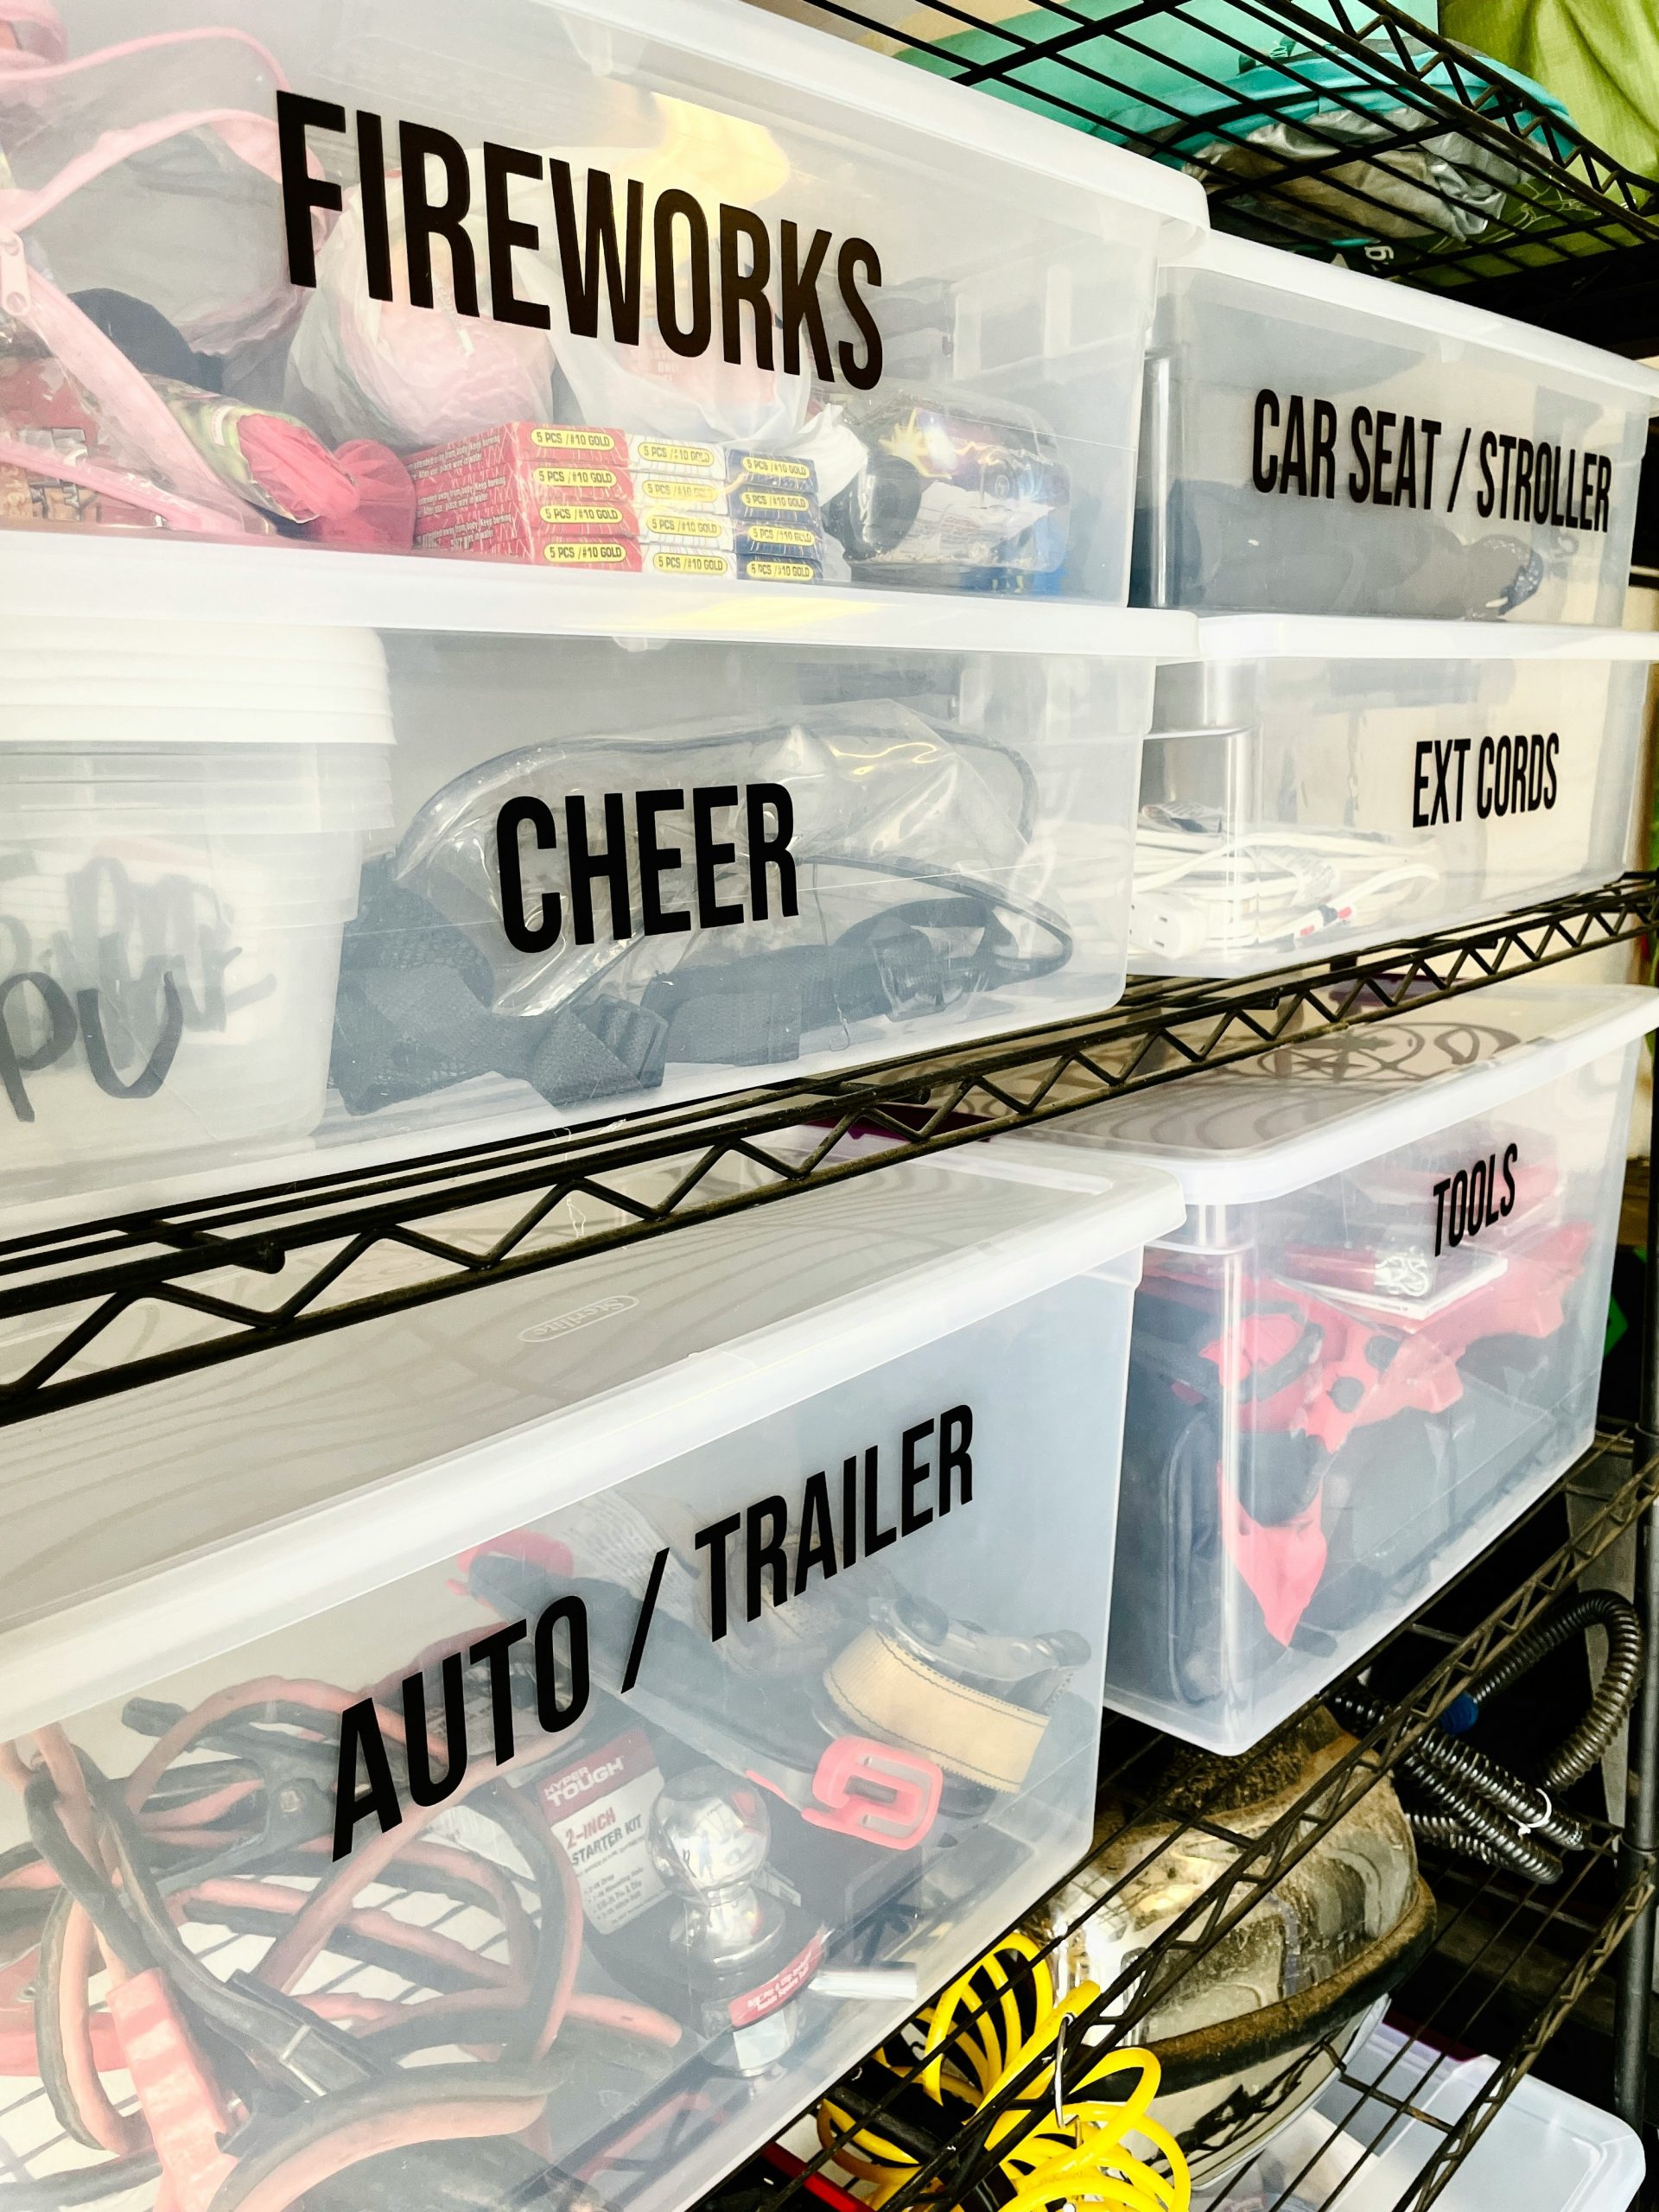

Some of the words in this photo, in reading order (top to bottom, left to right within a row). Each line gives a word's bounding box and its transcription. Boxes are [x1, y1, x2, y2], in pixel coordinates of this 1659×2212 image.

[276, 90, 883, 391] FIREWORKS
[537, 432, 543, 442] 5
[545, 433, 562, 444] PCS
[588, 435, 610, 447] GOLD
[644, 446, 649, 456] 5
[652, 447, 667, 458] PCS
[747, 460, 753, 468] 5
[754, 461, 769, 471] PCS
[789, 465, 807, 475] GOLD
[1253, 389, 1338, 499] CAR
[1348, 405, 1442, 511] SEAT
[1446, 428, 1471, 513] /
[1477, 430, 1611, 533] STROLLER
[539, 471, 544, 482] 5
[548, 471, 565, 482] PCS
[590, 473, 613, 484] GOLD
[648, 484, 653, 493] 5
[655, 484, 671, 495] PCS
[746, 494, 751, 503] 5
[753, 495, 767, 505] PCS
[788, 497, 805, 508] GOLD
[545, 509, 551, 518] 5
[554, 509, 571, 519] PCS
[596, 510, 619, 519] GOLD
[652, 520, 657, 529] 5
[659, 520, 675, 530] PCS
[698, 524, 717, 533] GOLD
[753, 528, 759, 537] 5
[760, 529, 774, 539] PCS
[550, 547, 556, 558] 5
[558, 547, 575, 558] PCS
[600, 547, 622, 558] GOLD
[658, 556, 664, 567] 5
[665, 556, 681, 568] PCS
[703, 559, 723, 570] GOLD
[751, 565, 756, 574] 5
[758, 565, 772, 575] PCS
[791, 566, 810, 577] GOLD
[1412, 738, 1471, 828] EXT
[1477, 733, 1560, 819] CORDS
[496, 783, 799, 954] CHEER
[1433, 1143, 1518, 1257] TOOLS
[532, 1298, 624, 1336] Sterilite
[332, 1595, 590, 1863] AUTO
[620, 1547, 670, 1694] /
[695, 1404, 973, 1643] TRAILER
[543, 1766, 589, 1795] HYPER
[546, 1758, 625, 1807] TOUGH
[566, 1807, 616, 1850] 2-INCH
[571, 1827, 623, 1866] STARTER
[625, 1814, 643, 1834] KIT
